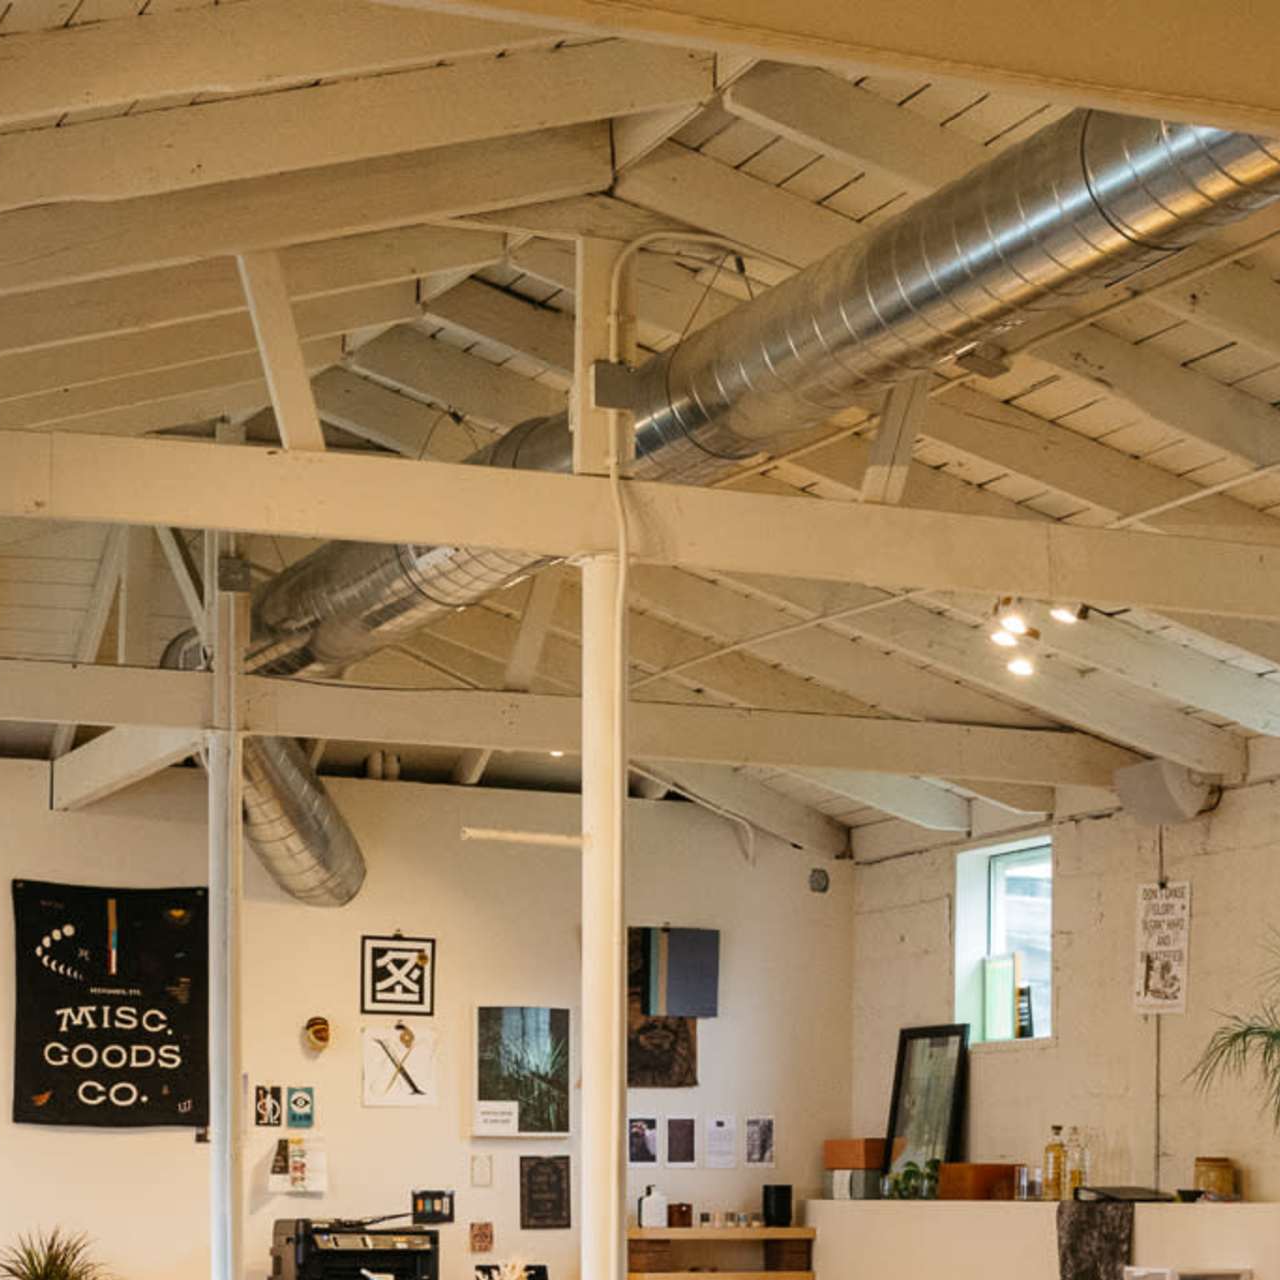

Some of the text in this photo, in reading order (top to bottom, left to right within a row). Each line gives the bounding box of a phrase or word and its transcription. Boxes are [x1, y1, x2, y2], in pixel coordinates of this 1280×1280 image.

[55, 1005, 173, 1036] MISC.
[43, 1042, 182, 1069] GOODS
[77, 1081, 149, 1106] CO.
